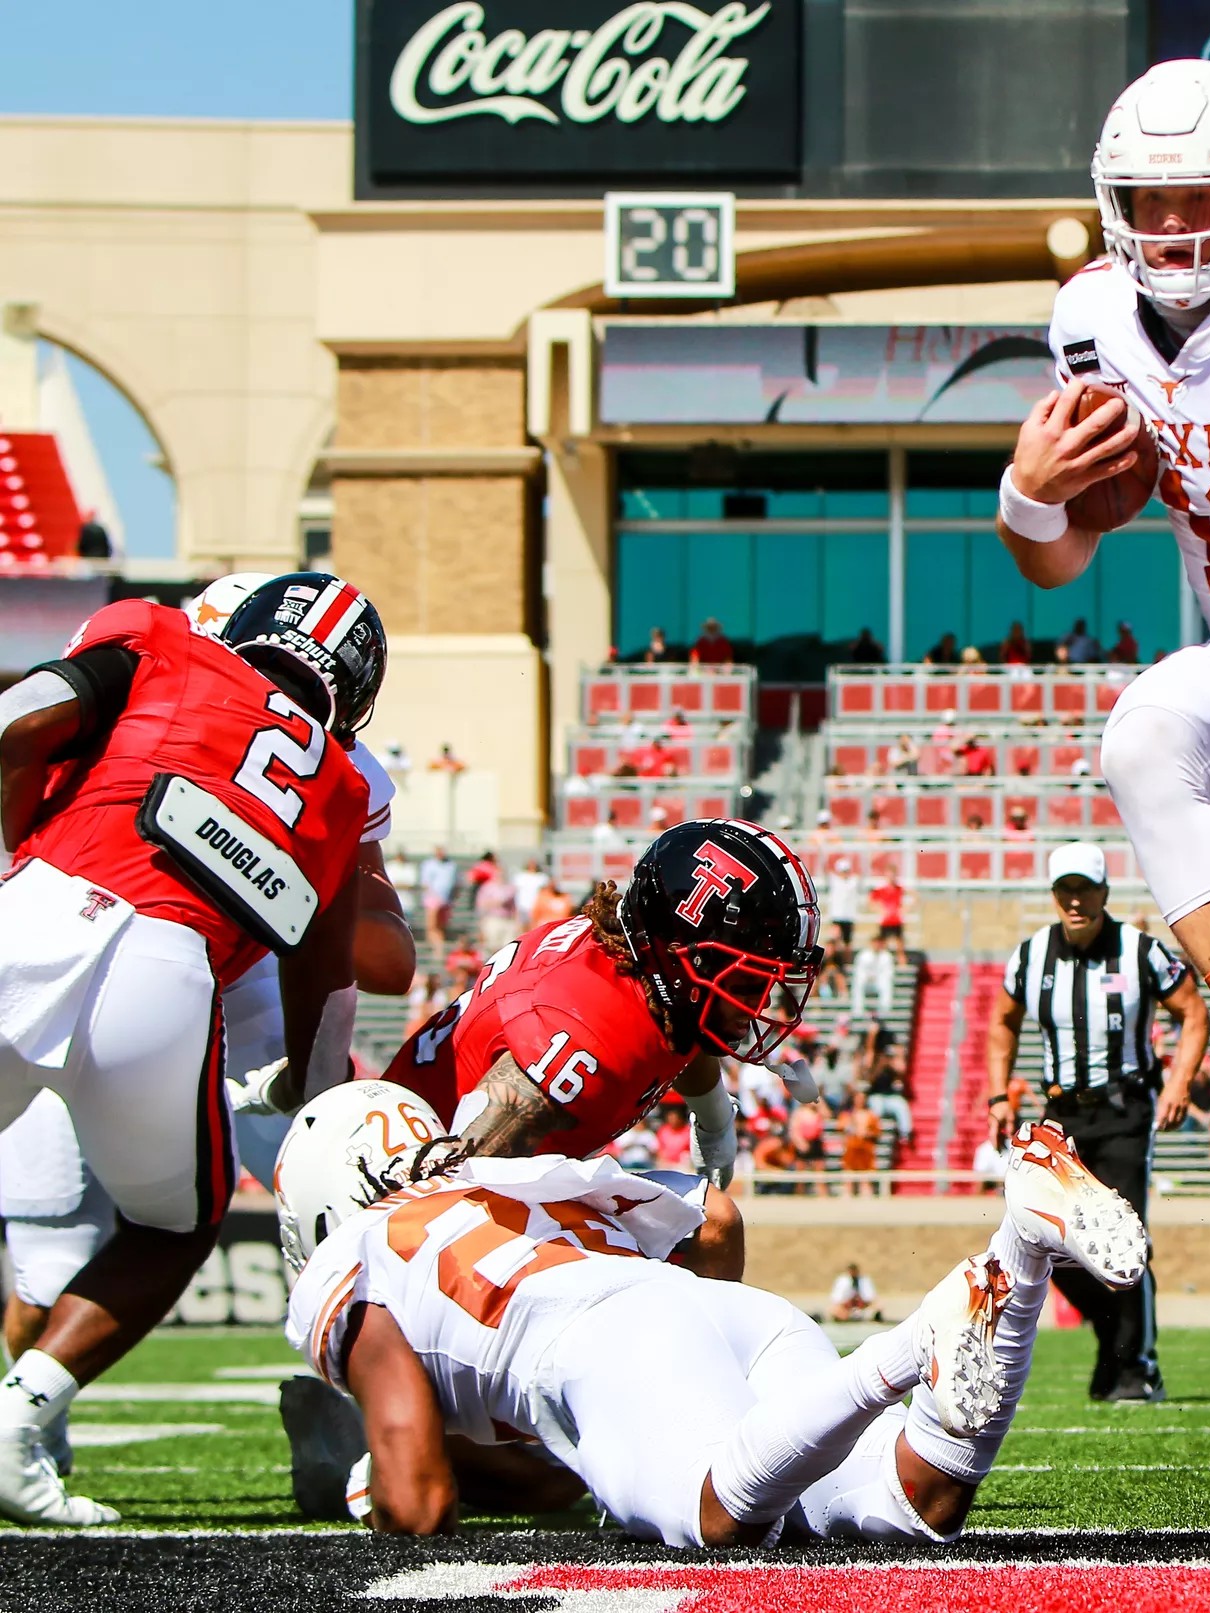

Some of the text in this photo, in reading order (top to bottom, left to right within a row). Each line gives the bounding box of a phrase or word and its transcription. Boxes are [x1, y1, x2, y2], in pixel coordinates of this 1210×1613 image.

[390, 1, 772, 125] Coca-Cola
[621, 208, 718, 281] 20
[281, 629, 337, 670] schutt
[234, 690, 326, 829] 2
[195, 817, 287, 900] DOUGLAS
[1108, 1012, 1123, 1031] R
[525, 1030, 599, 1104] 16
[365, 1102, 433, 1157] 26
